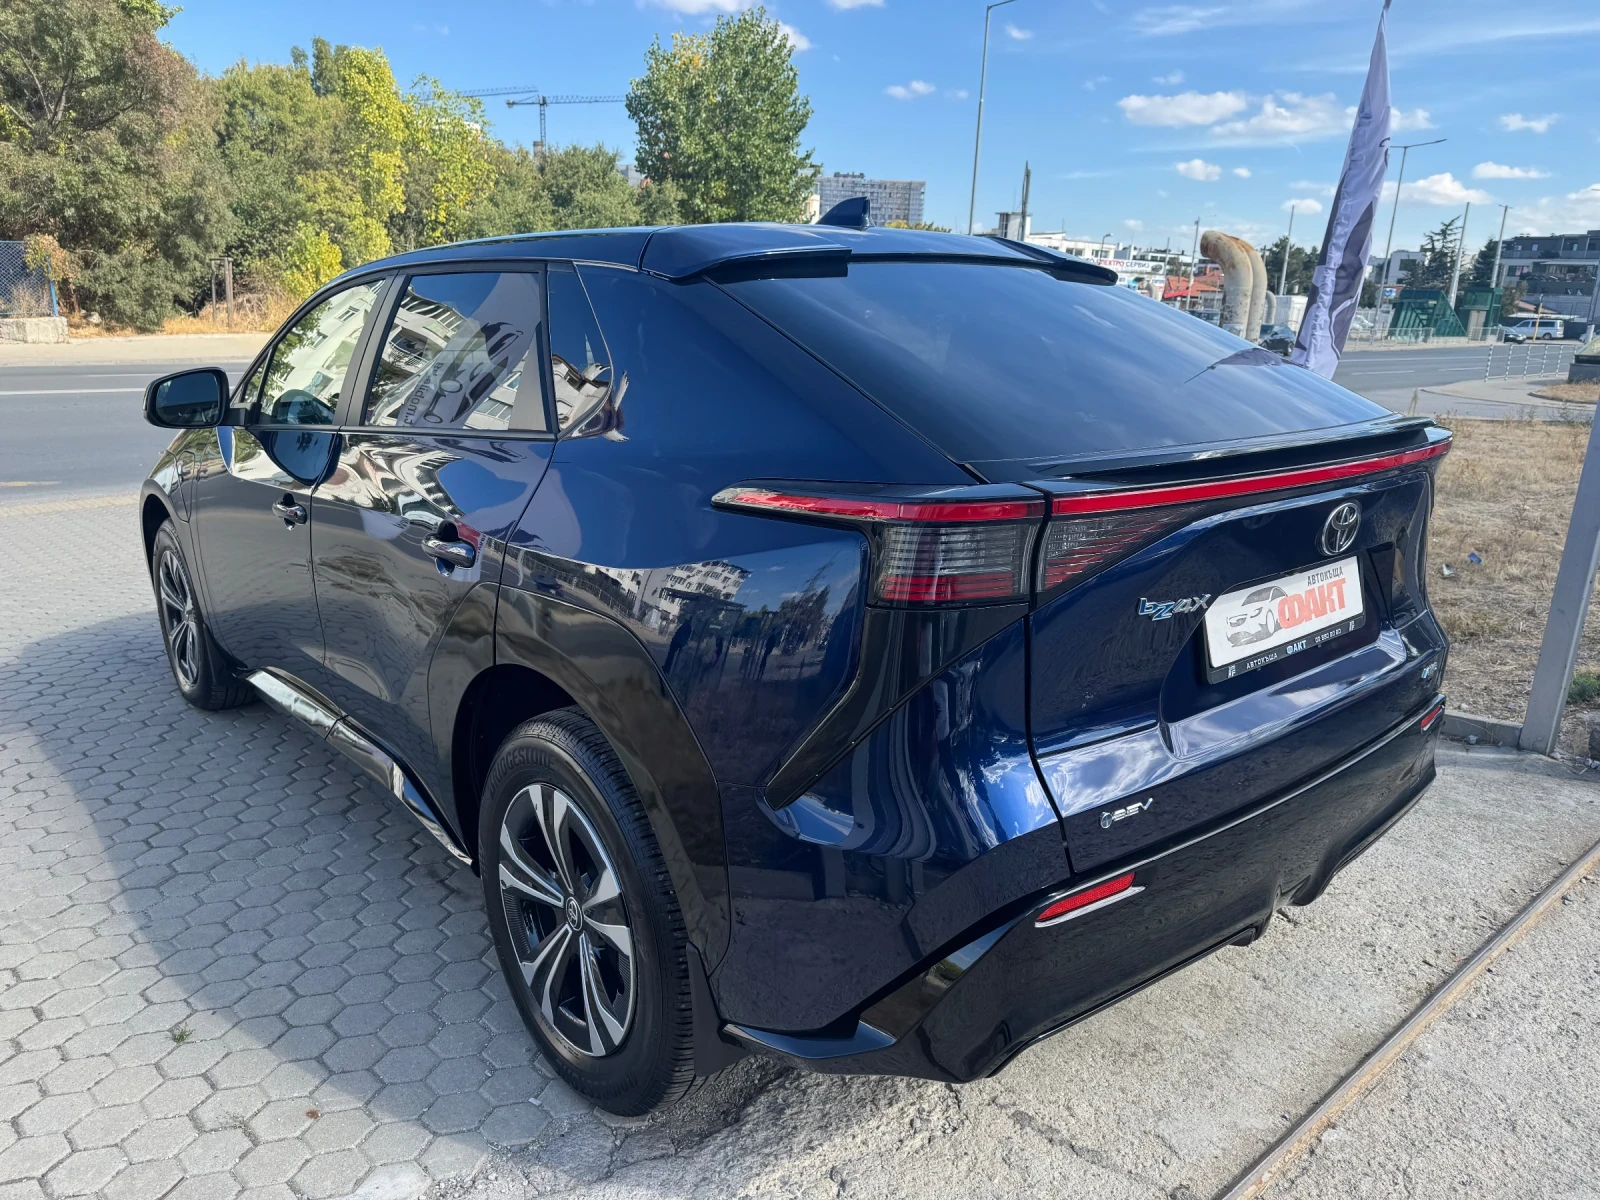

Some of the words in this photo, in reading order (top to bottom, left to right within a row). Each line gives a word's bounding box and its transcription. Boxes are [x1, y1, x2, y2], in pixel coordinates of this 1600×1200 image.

[1307, 566, 1344, 587] АВТОКЪЩА
[1278, 577, 1346, 630] ФАКТ
[1246, 652, 1278, 670] АВТОКЪЩА
[1286, 640, 1307, 655] ФАКТ
